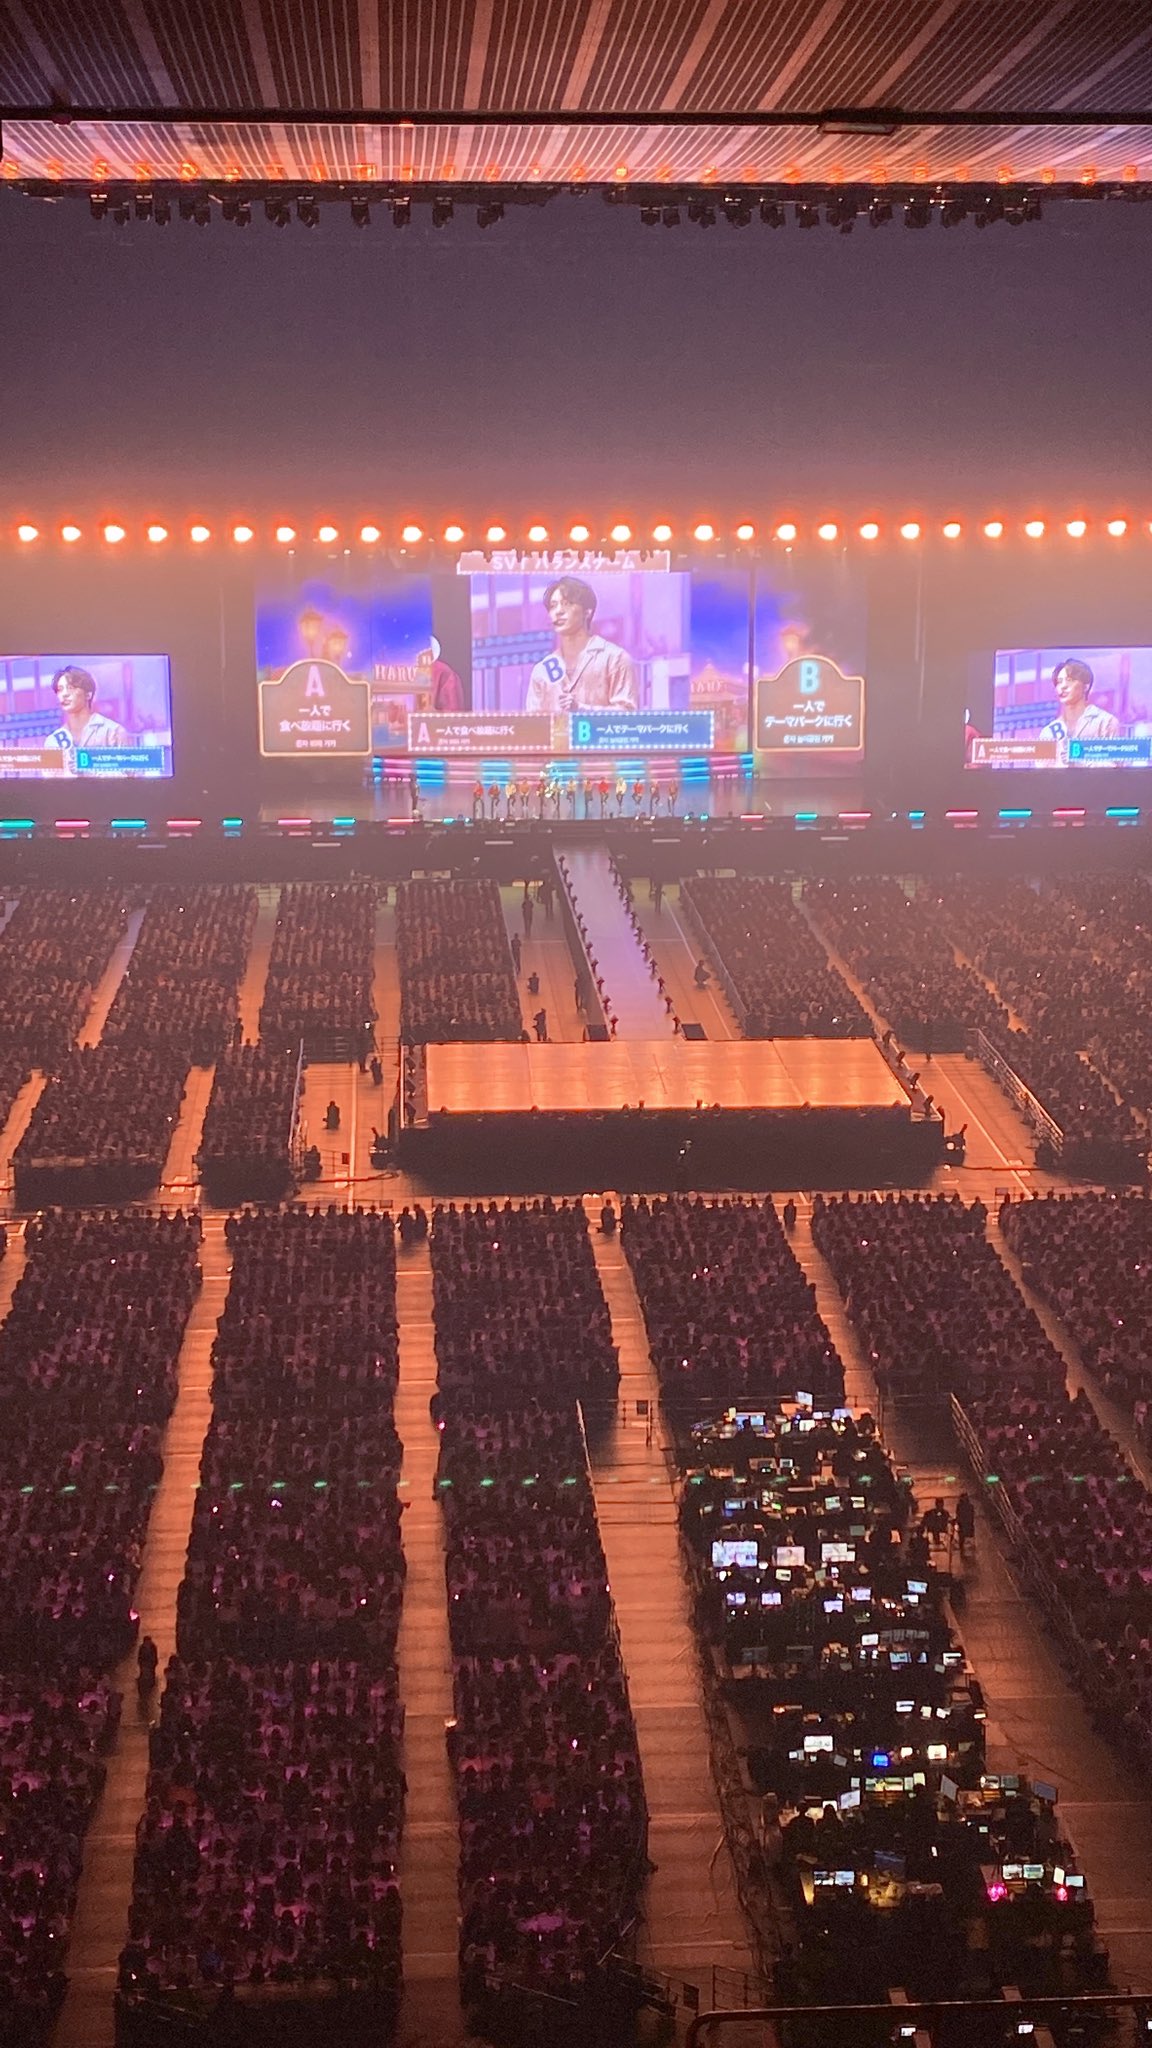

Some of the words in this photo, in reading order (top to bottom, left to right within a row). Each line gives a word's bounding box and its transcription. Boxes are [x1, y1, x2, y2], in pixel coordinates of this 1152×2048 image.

[542, 657, 564, 683] B
[799, 660, 820, 695] B
[304, 664, 325, 697] A
[298, 704, 331, 717] 一人で
[793, 700, 826, 713] 一人で
[54, 731, 71, 749] B
[417, 722, 431, 743] A
[578, 720, 591, 742] B
[1049, 722, 1066, 742] B
[80, 752, 88, 767] B
[977, 744, 986, 758] A
[1072, 743, 1080, 757] B
